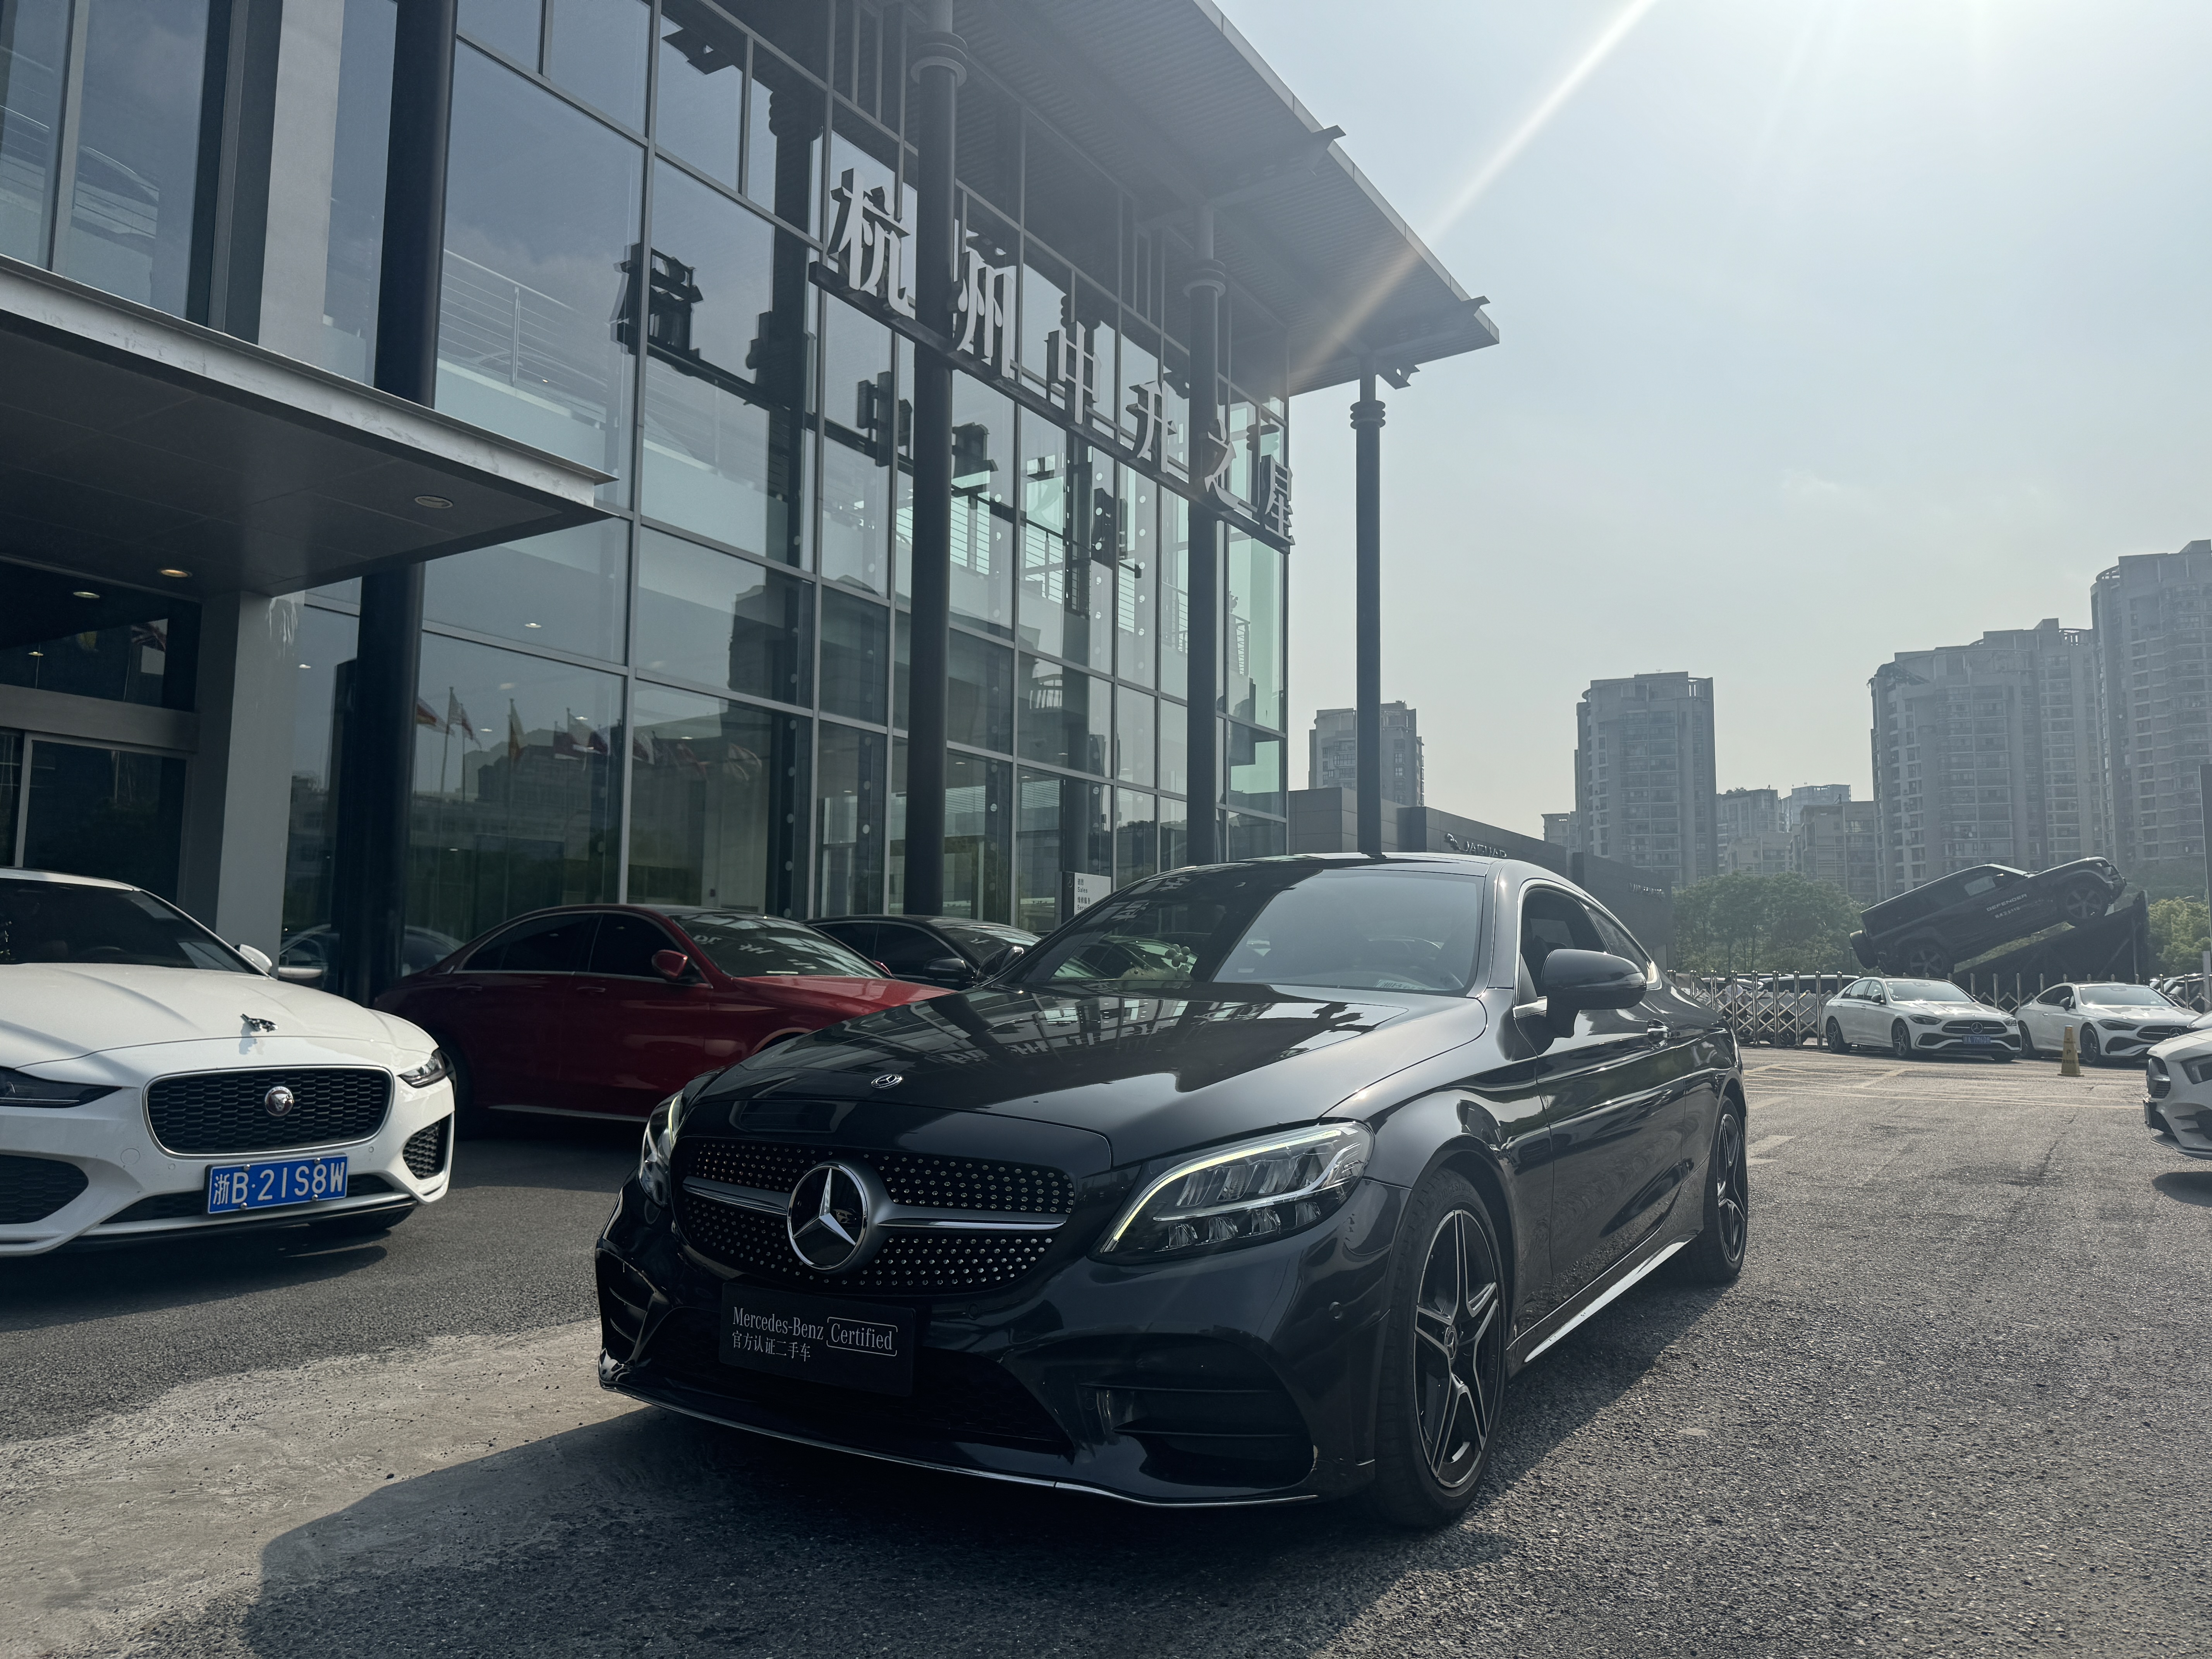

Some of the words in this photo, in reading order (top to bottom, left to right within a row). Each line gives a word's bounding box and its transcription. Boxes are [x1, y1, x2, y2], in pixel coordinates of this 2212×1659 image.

[827, 168, 1295, 545] 杭州中升之星
[1987, 893, 2027, 911] DEFENDER
[213, 1162, 345, 1206] 浙B·21S8W
[732, 1306, 824, 1340] Mercedes-Benz
[831, 1323, 893, 1350] Certified
[732, 1330, 811, 1362] 官方认证二手车
